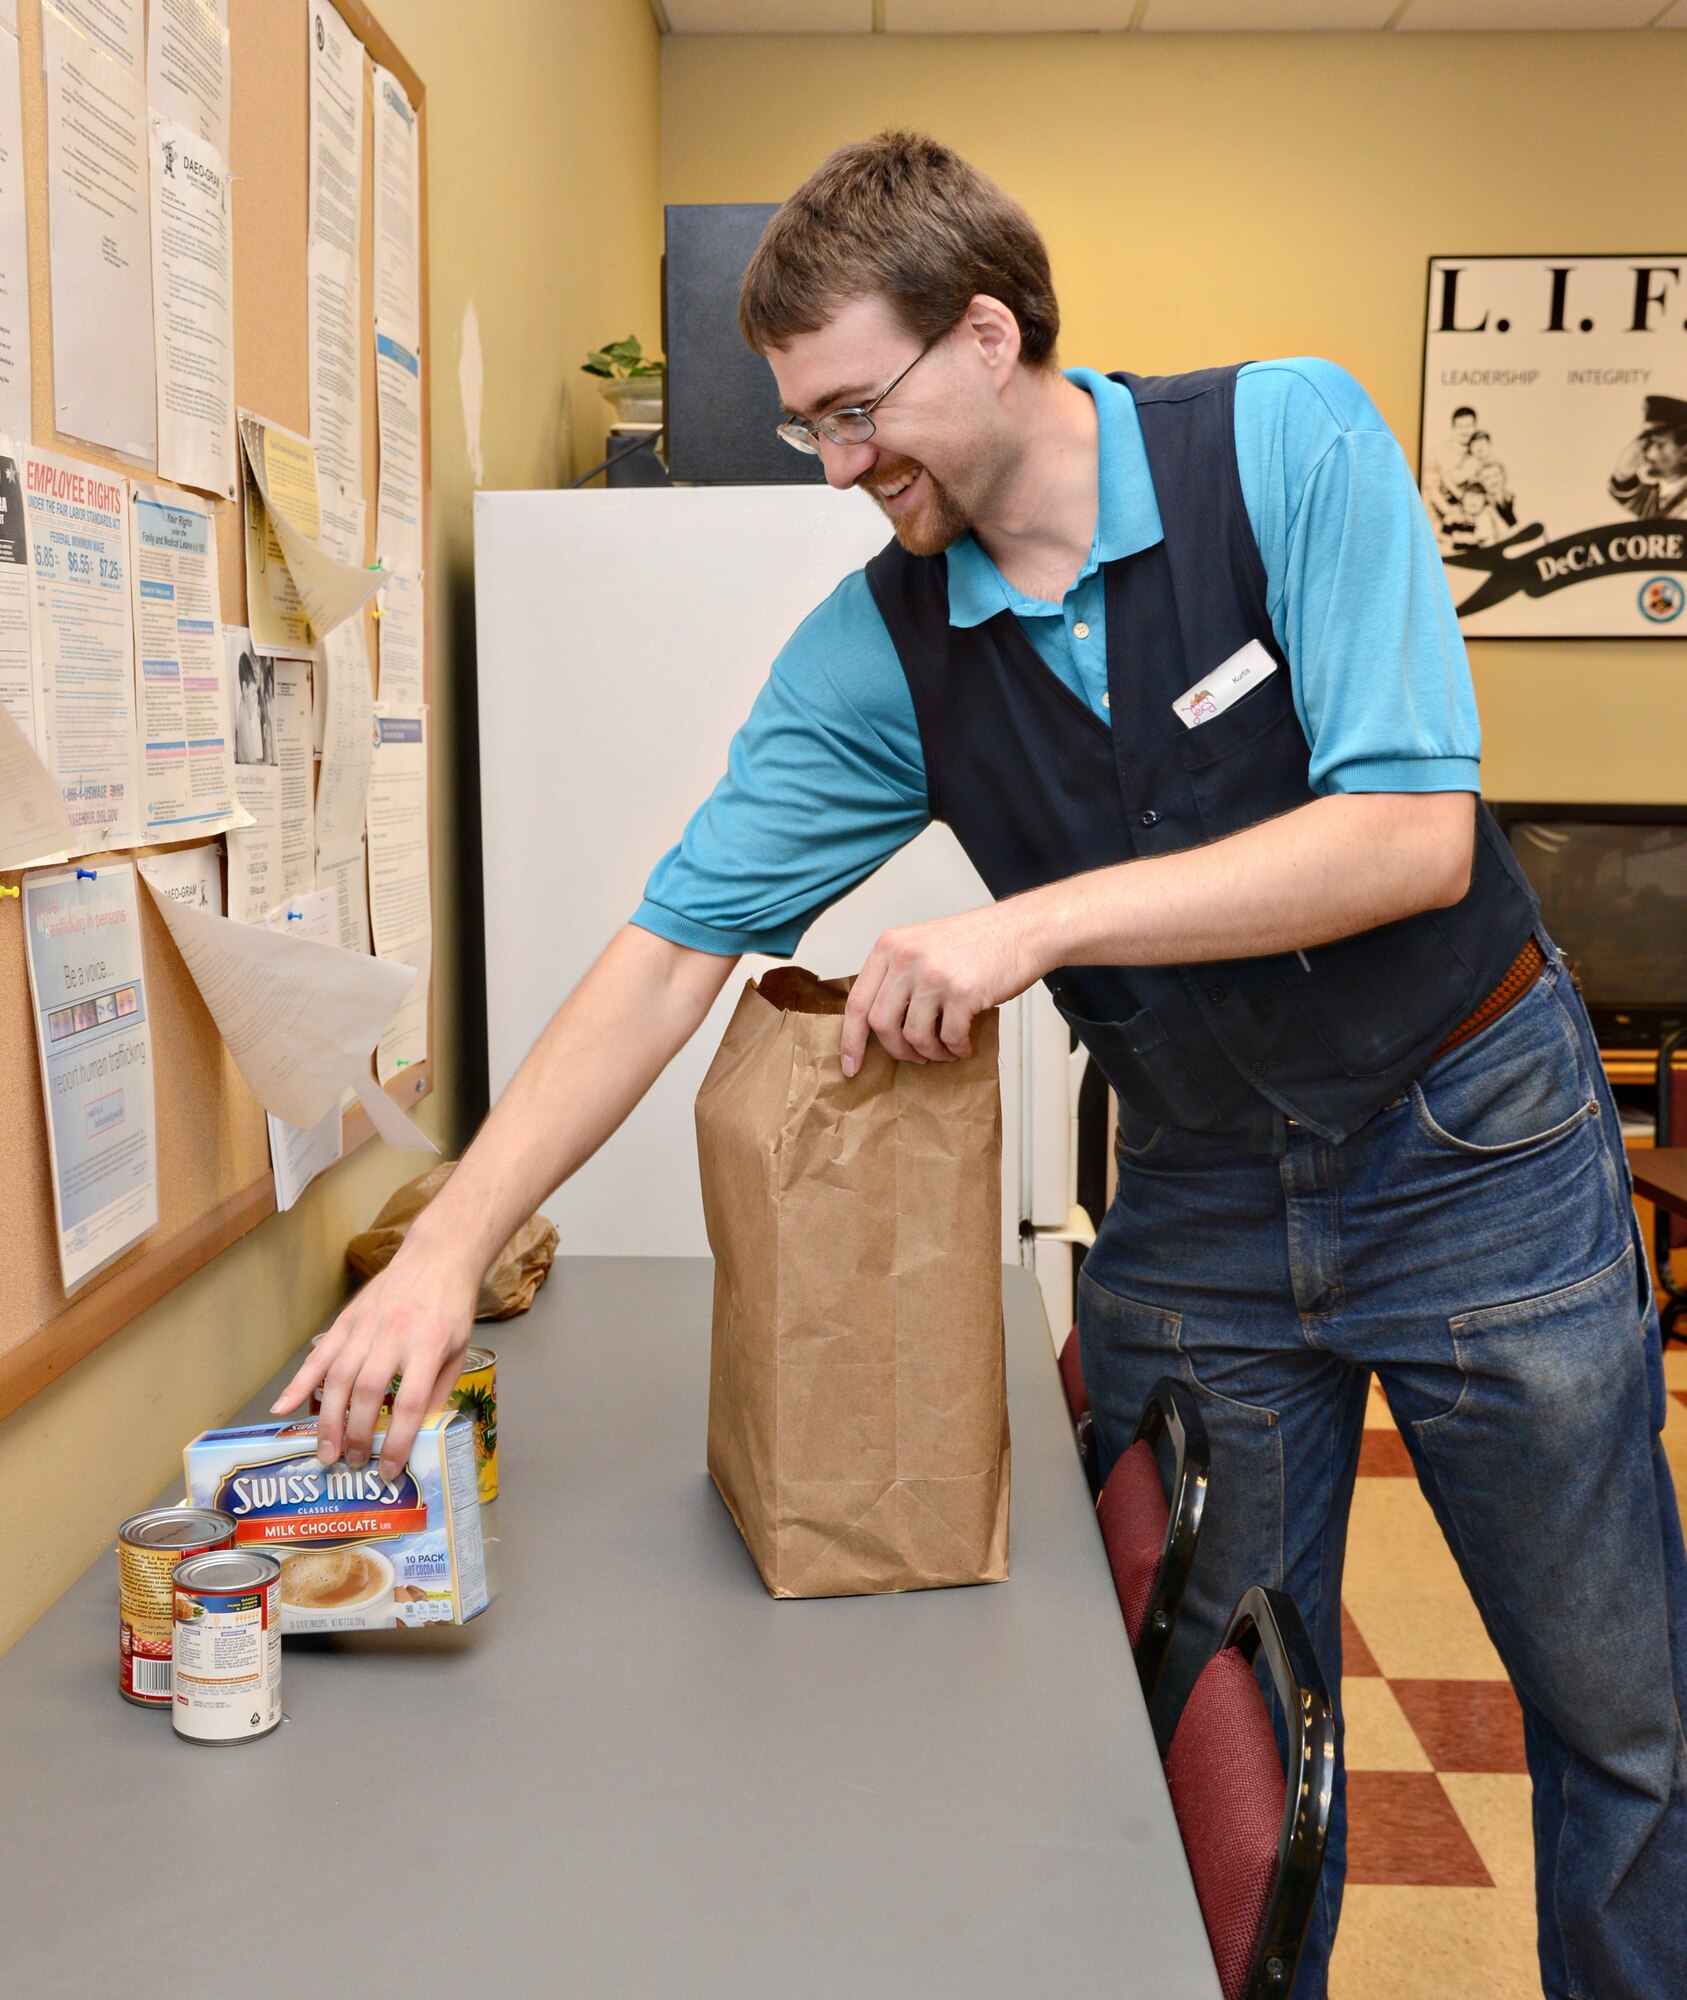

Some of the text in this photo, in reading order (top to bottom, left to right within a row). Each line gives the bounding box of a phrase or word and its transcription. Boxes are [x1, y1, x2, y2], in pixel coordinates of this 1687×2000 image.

[1441, 368, 1540, 387] LEADERSHIP
[1566, 368, 1652, 387] INTEGRITY
[27, 460, 121, 515] EMPLOYEE RIGHTS
[28, 494, 45, 511] UNDER
[45, 499, 56, 514] THE
[56, 502, 69, 517] FAIR
[69, 504, 86, 521] LABOR
[86, 510, 112, 529] STANDARDS
[112, 518, 121, 530] ACT
[167, 513, 193, 529] Your Rights
[50, 531, 71, 547] FEDERAL
[142, 531, 155, 547] Family
[68, 551, 89, 574] $6.55
[1536, 534, 1683, 583] DeCA CORE
[99, 557, 119, 580] $7.25
[1231, 667, 1251, 684] Kurtis
[95, 909, 127, 928] persons
[64, 964, 77, 990] Be
[78, 967, 84, 985] a
[79, 1062, 109, 1085] human
[109, 1040, 146, 1072] trafficking
[232, 1474, 320, 1515] SWISS
[297, 1505, 339, 1515] CLASSICS
[265, 1524, 296, 1538] MILK
[299, 1519, 378, 1535] CHOCOLATE
[405, 1553, 445, 1564] 10 PACK
[404, 1562, 447, 1576] HOT COCOA MIX
[405, 1604, 414, 1613] 90
